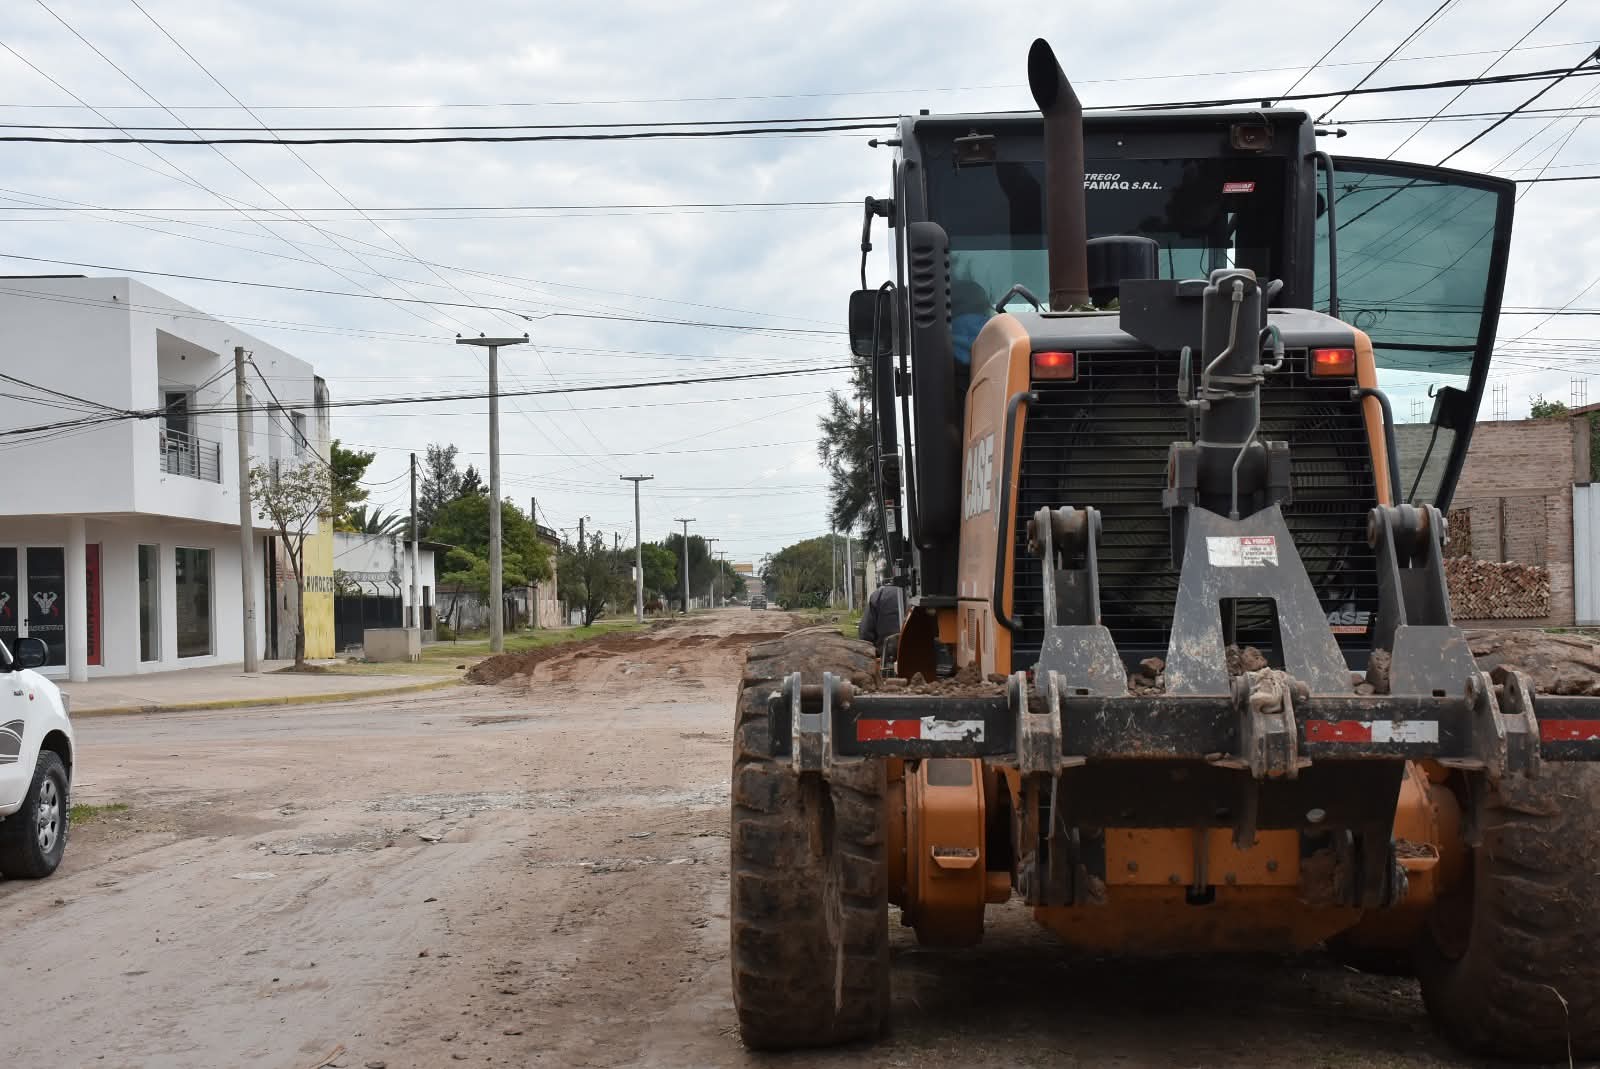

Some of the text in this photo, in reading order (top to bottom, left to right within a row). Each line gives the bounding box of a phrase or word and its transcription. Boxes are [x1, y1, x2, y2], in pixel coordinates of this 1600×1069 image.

[1131, 181, 1163, 190] S.R.L.
[964, 433, 995, 520] CASE
[1327, 611, 1371, 625] ASE
